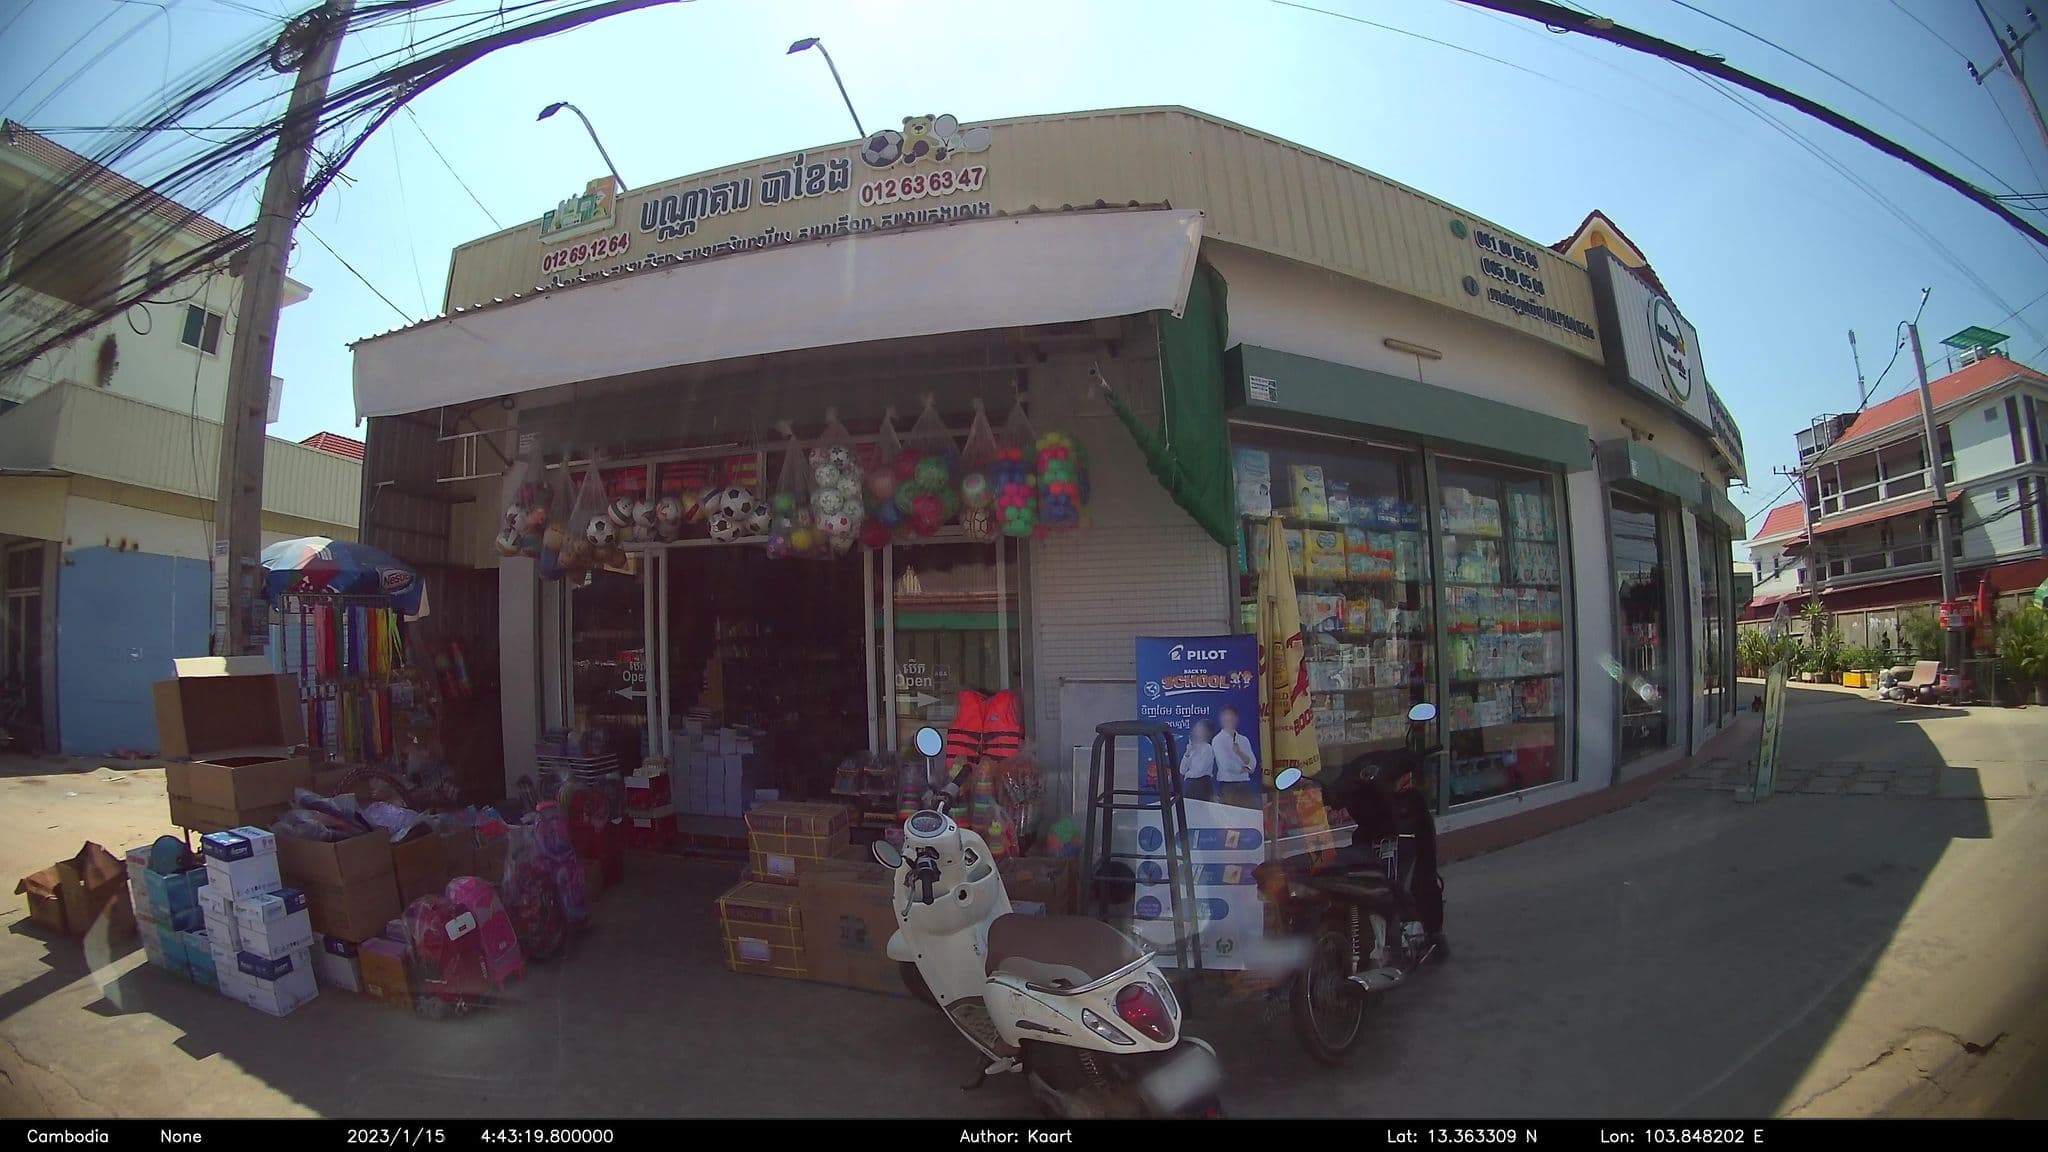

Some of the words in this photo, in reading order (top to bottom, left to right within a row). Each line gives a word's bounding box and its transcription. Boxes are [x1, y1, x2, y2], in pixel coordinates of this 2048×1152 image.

[862, 180, 897, 204] 012
[900, 174, 925, 198] 63
[930, 170, 955, 193] 63
[957, 167, 987, 188] 47
[543, 250, 567, 272] 012
[569, 244, 587, 264] 69
[590, 240, 607, 258] 12
[608, 232, 629, 251] 64
[1187, 649, 1227, 661] PILOT
[622, 670, 646, 685] Ope
[895, 673, 932, 690] Open
[1161, 674, 1230, 690] SCHOOL
